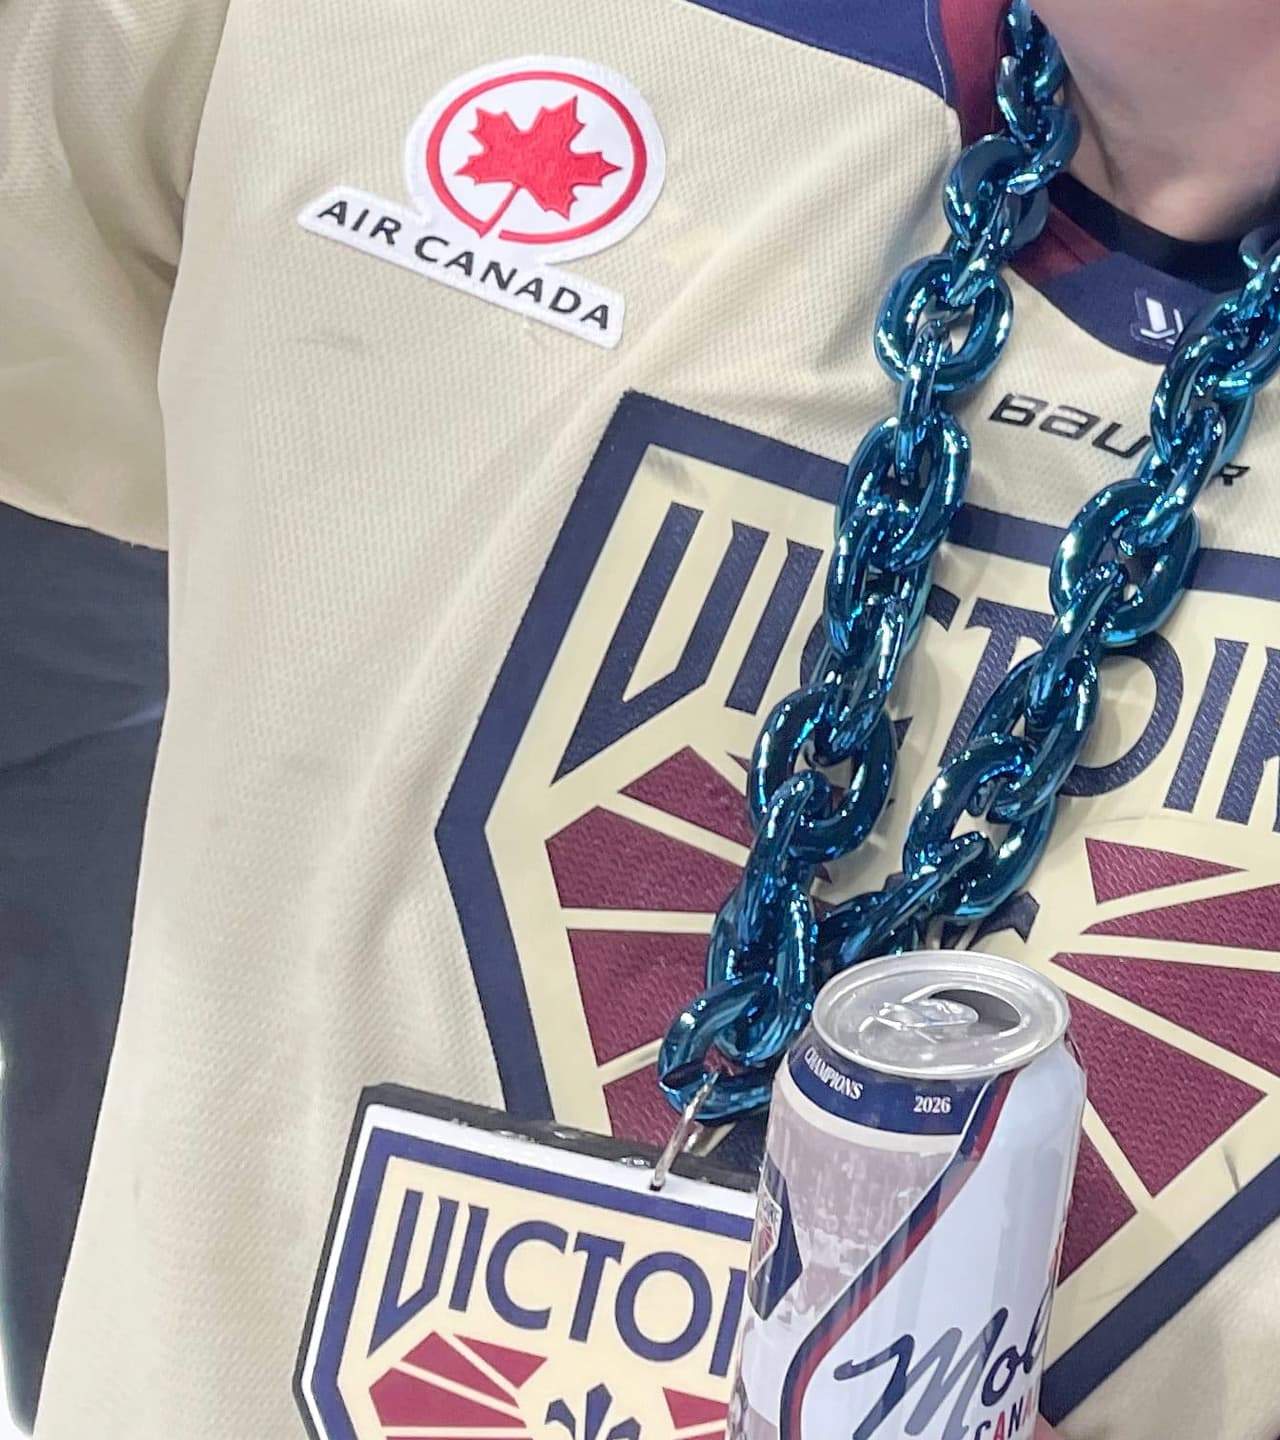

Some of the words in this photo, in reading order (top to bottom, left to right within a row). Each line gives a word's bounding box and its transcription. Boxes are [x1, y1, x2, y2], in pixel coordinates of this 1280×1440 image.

[316, 200, 402, 246] AIR
[414, 235, 610, 330] CANADA
[804, 1046, 864, 1101] CHAMPIONS
[912, 1095, 952, 1114] 2026
[367, 1188, 747, 1378] VICTOI
